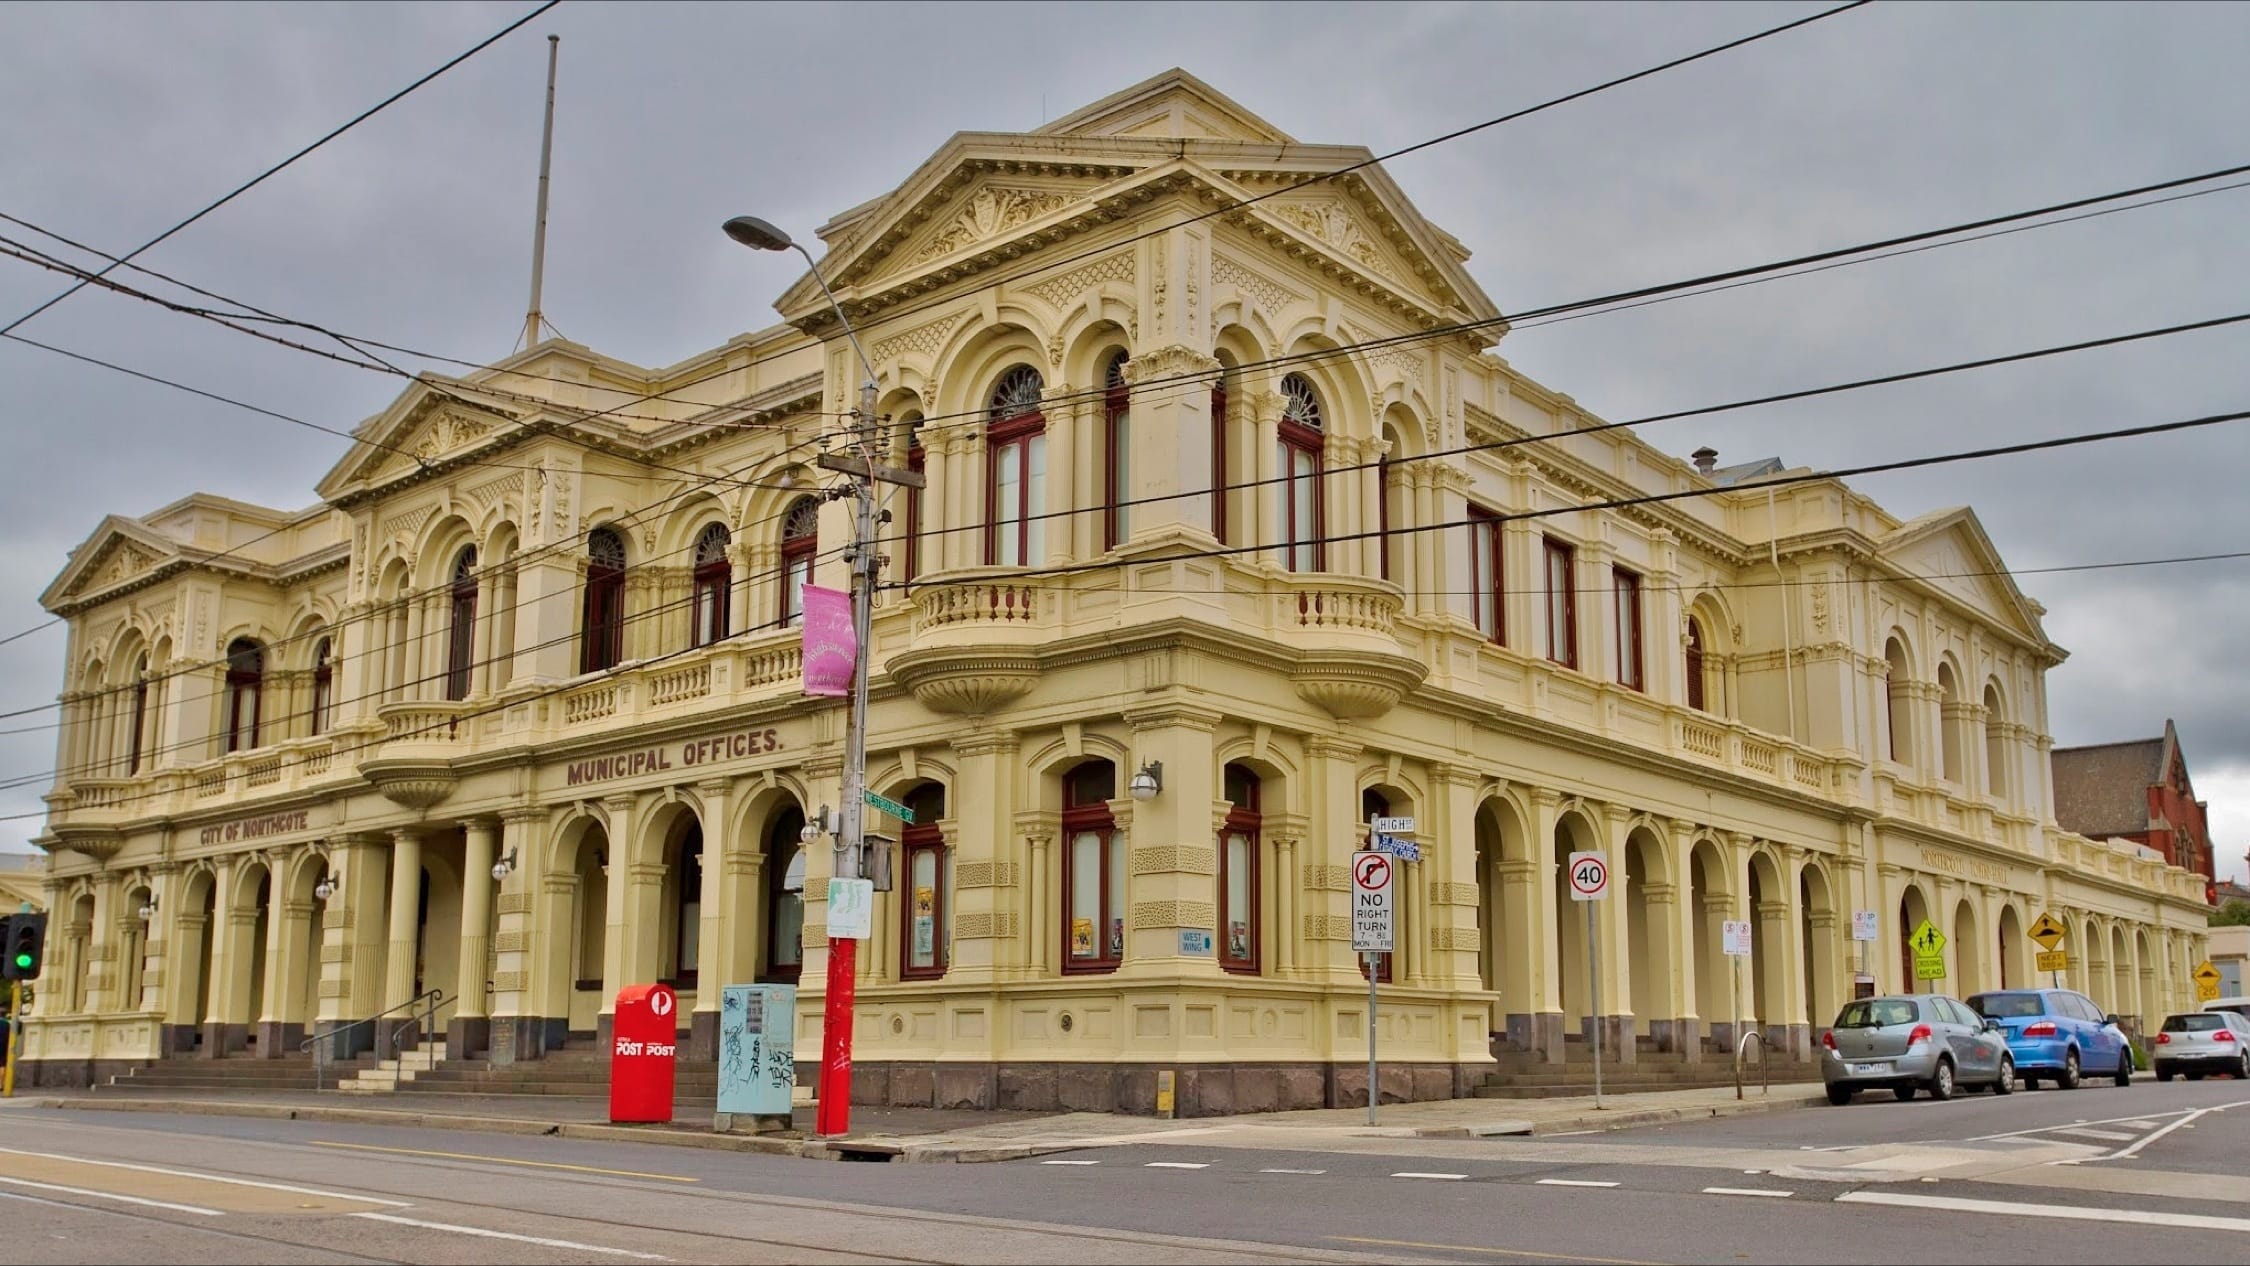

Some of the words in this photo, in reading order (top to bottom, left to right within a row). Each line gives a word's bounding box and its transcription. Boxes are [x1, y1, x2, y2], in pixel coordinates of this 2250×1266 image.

[567, 748, 671, 786] MUNICIPAL
[683, 729, 784, 765] OFFICES.
[865, 791, 903, 817] WESTBOURNE
[200, 825, 223, 845] CITY
[225, 823, 239, 841] OF
[243, 811, 308, 839] NORTHCOTE
[1380, 819, 1405, 830] HIGH
[1577, 866, 1601, 884] 40
[1361, 894, 1383, 906] NO
[1357, 909, 1389, 919] RIGHT
[1357, 922, 1387, 931] TURN
[1182, 932, 1201, 942] WEST
[1182, 942, 1202, 952] WING
[1917, 959, 1942, 967] CROSSING
[1919, 968, 1942, 976] AHEAD
[2203, 987, 2217, 997] 20
[616, 1042, 643, 1056] POST
[646, 1045, 675, 1056] POST
